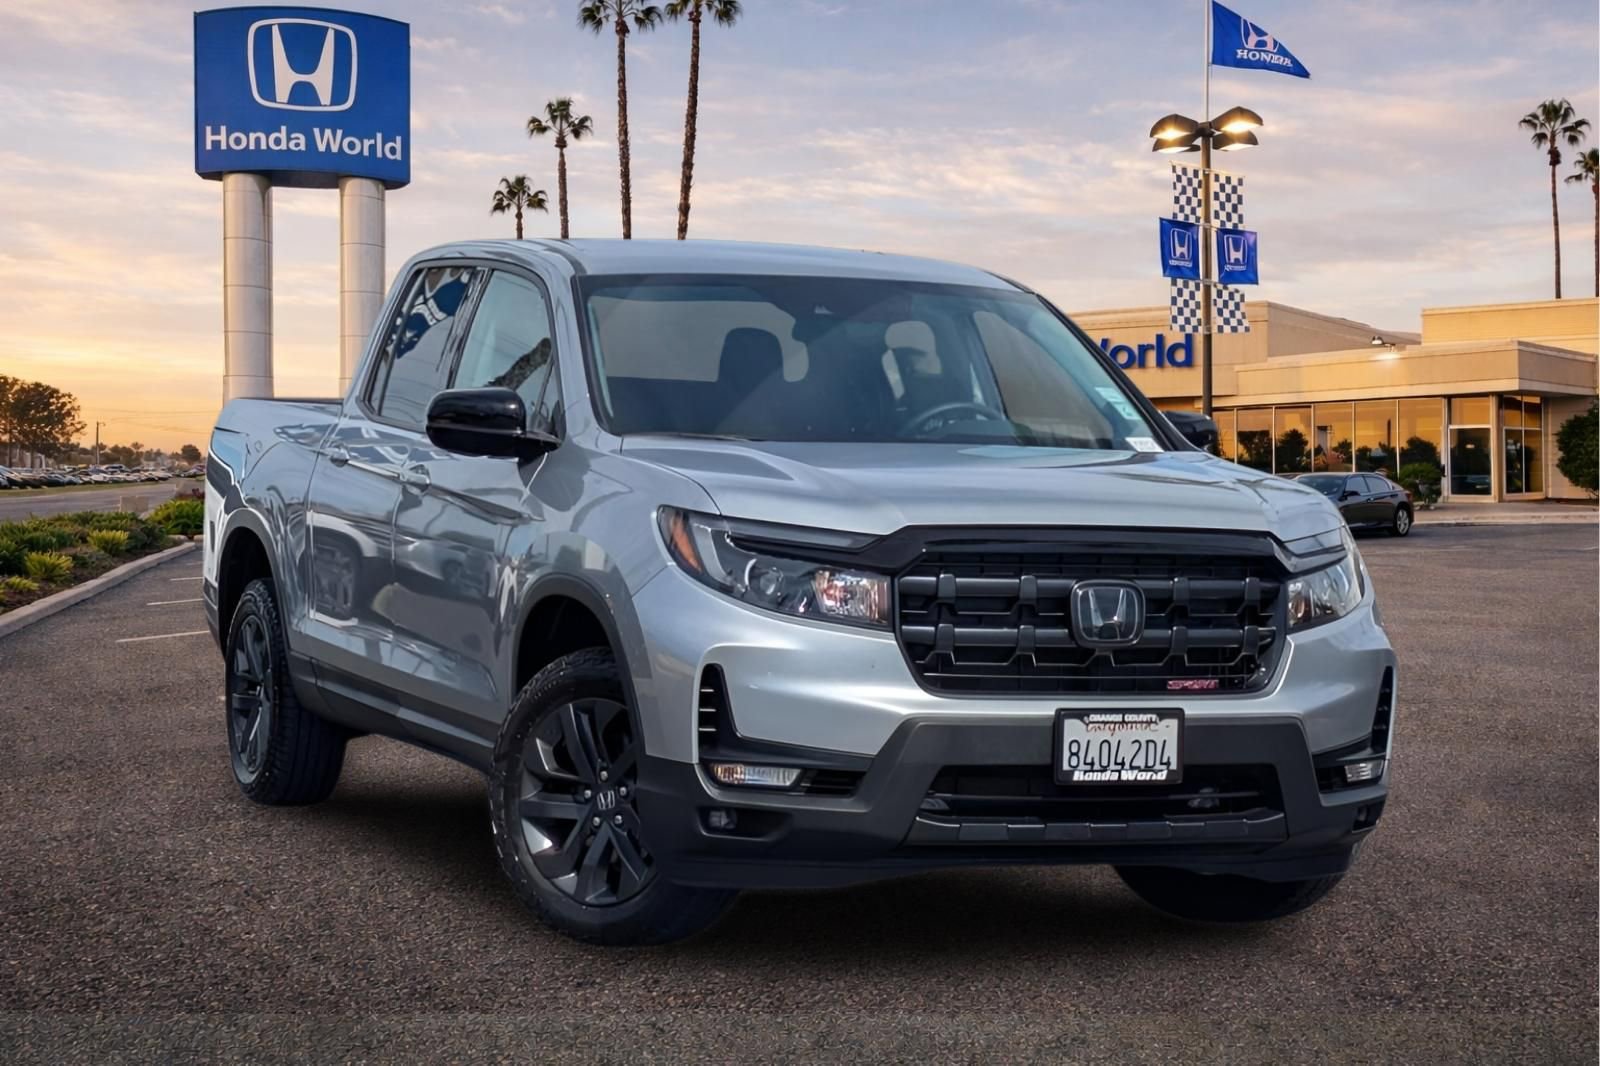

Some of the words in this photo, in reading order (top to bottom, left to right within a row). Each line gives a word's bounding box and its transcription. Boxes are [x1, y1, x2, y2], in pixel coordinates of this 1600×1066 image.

[205, 125, 306, 151] Honda
[312, 128, 402, 161] World
[1100, 333, 1193, 369] orld
[1067, 739, 1171, 770] 84042D4
